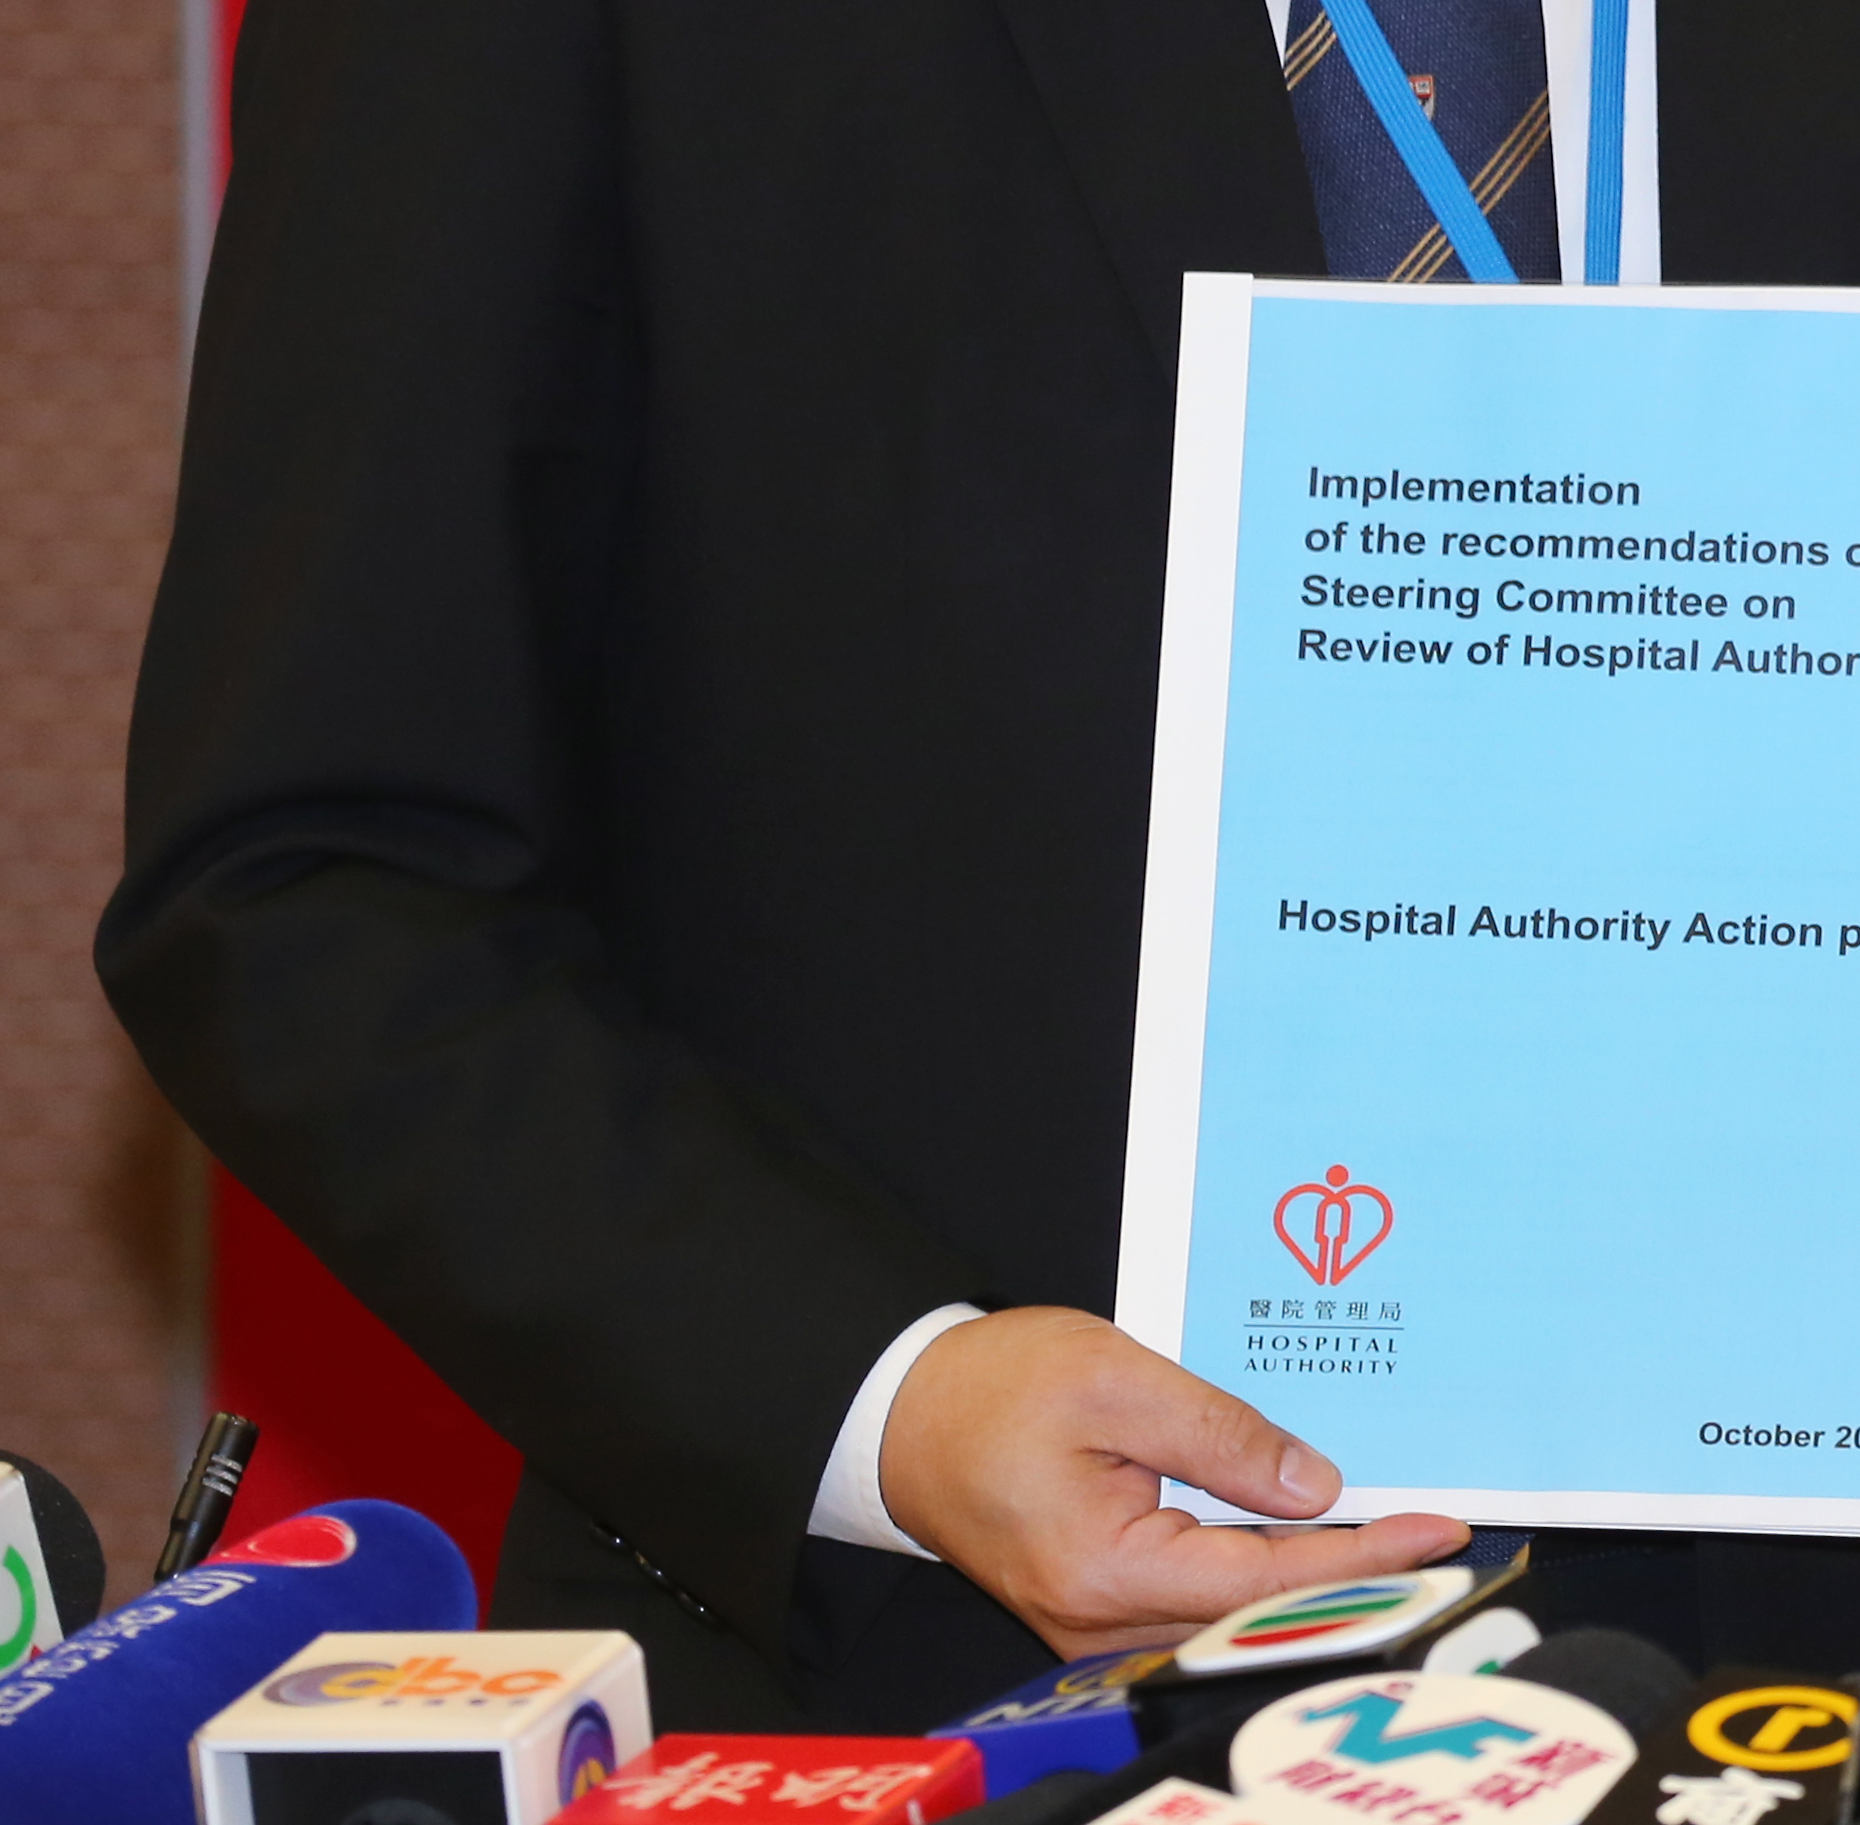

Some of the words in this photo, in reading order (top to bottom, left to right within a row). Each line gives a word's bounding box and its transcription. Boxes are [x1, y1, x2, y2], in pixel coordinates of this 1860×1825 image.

[1309, 467, 1639, 508] Implementation
[1305, 521, 1349, 552] of
[1360, 523, 1425, 555] the
[1442, 531, 1829, 566] recommendations
[1301, 574, 1479, 619] Steering
[1497, 580, 1727, 617] Committee
[1744, 595, 1795, 619] on
[1299, 629, 1453, 664] Review
[1467, 634, 1511, 665] of
[1524, 635, 1698, 677] Hospital
[1279, 899, 1456, 942] Hospital
[1468, 906, 1671, 951] Authority
[1683, 912, 1822, 947] Action
[1249, 1298, 1402, 1322] 醫院管理局
[1247, 1335, 1399, 1355] HOSPITAL
[1244, 1357, 1399, 1376] AUTHORITY
[1699, 1422, 1825, 1447] October
